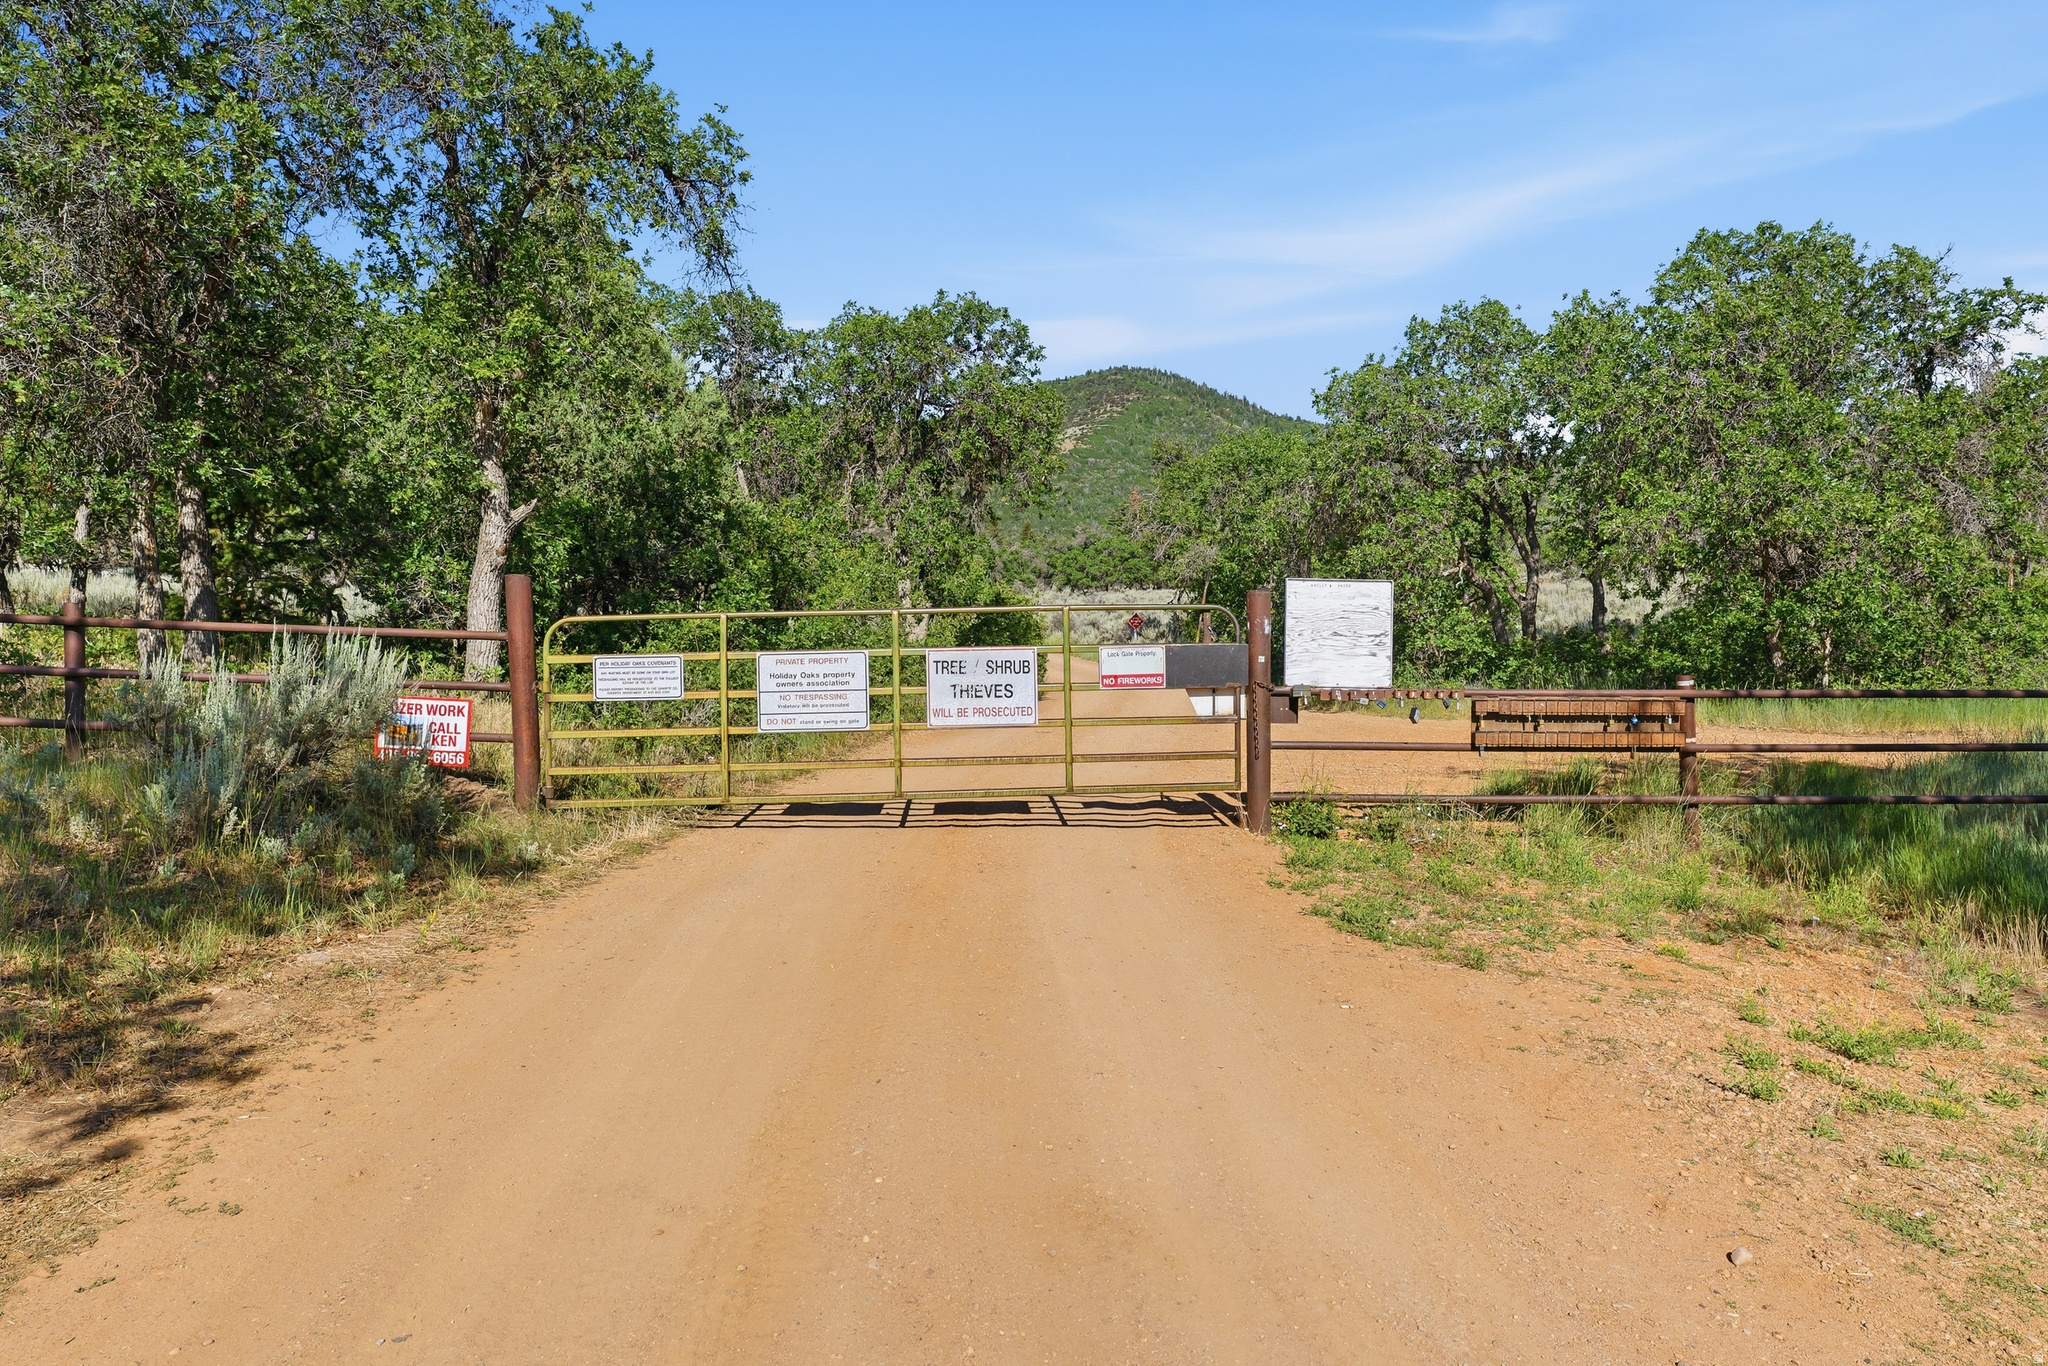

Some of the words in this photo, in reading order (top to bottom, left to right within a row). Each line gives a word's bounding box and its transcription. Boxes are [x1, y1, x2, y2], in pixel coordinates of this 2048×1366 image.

[933, 660, 967, 674] TREE
[986, 660, 1031, 674] SHRUB
[823, 671, 855, 679] property
[1118, 676, 1162, 684] FIREWORKS
[795, 693, 848, 701] TRESPASSING
[950, 684, 1014, 698] THIEVES
[426, 704, 465, 717] WORK
[932, 708, 953, 718] WILL
[957, 707, 969, 717] BE
[973, 707, 1033, 717] PROSECUTED
[429, 721, 461, 734] CALL
[431, 735, 457, 747] KEN
